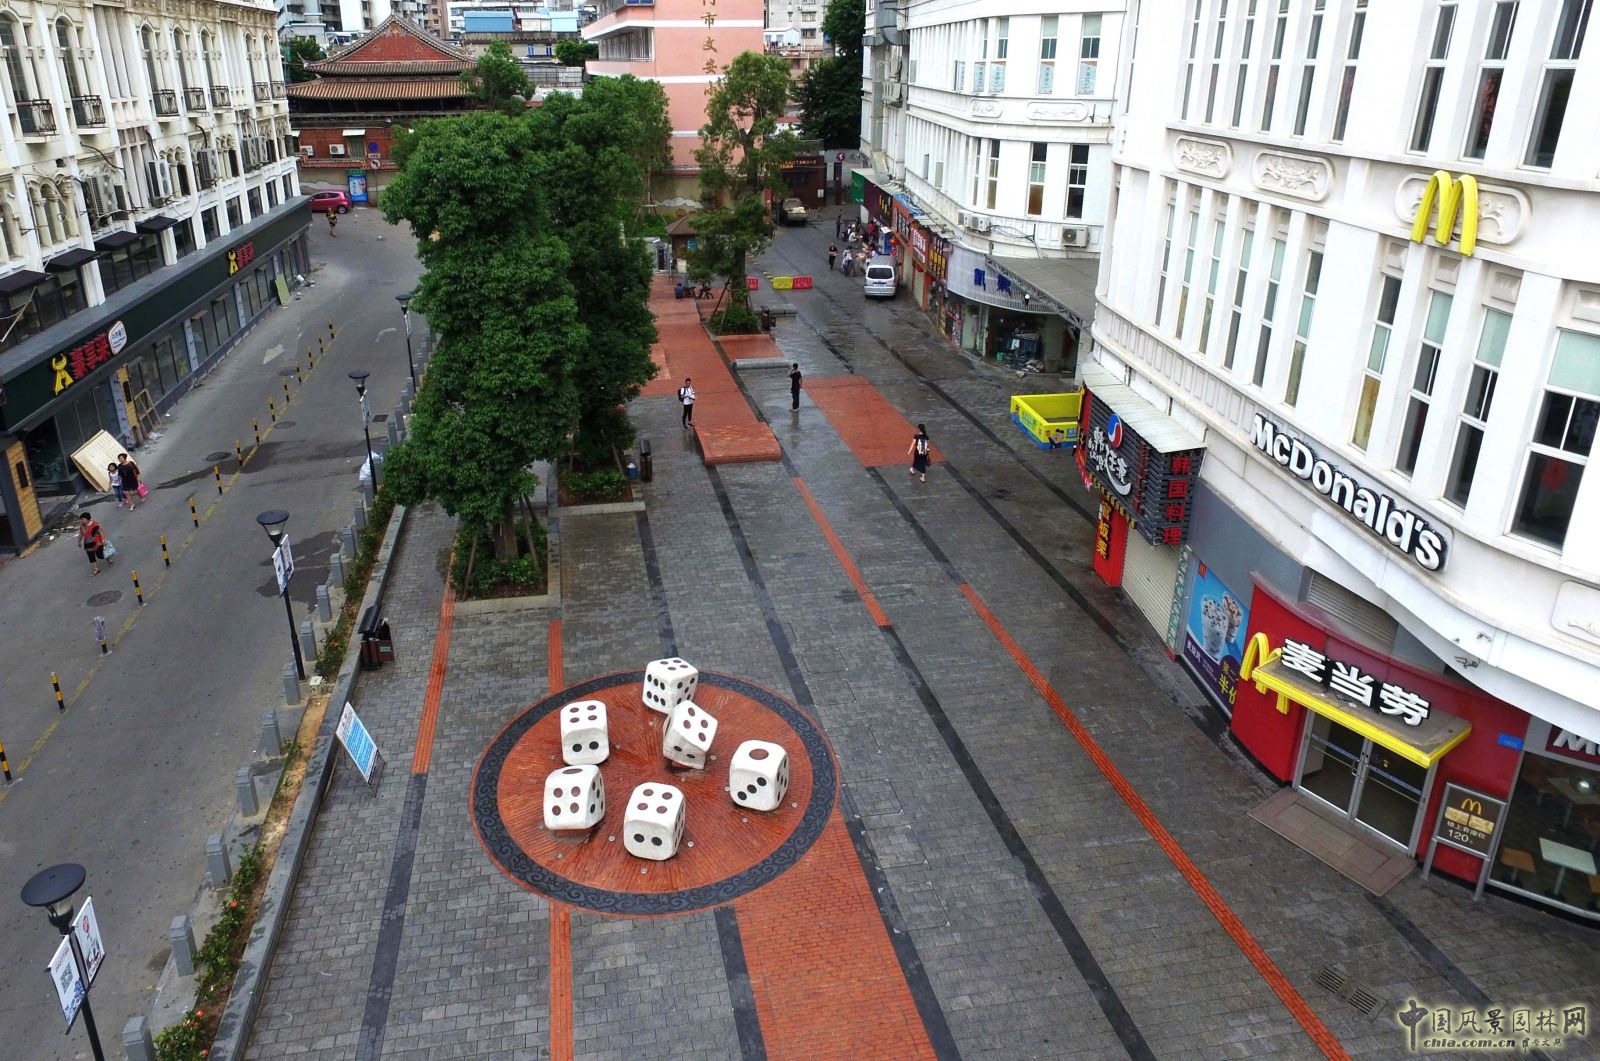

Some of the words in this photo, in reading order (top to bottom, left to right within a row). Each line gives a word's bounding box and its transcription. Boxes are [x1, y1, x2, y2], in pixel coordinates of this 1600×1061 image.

[1162, 455, 1192, 545] 韩国料理
[1249, 412, 1446, 572] McDonald's
[1281, 638, 1430, 727] 麦当劳
